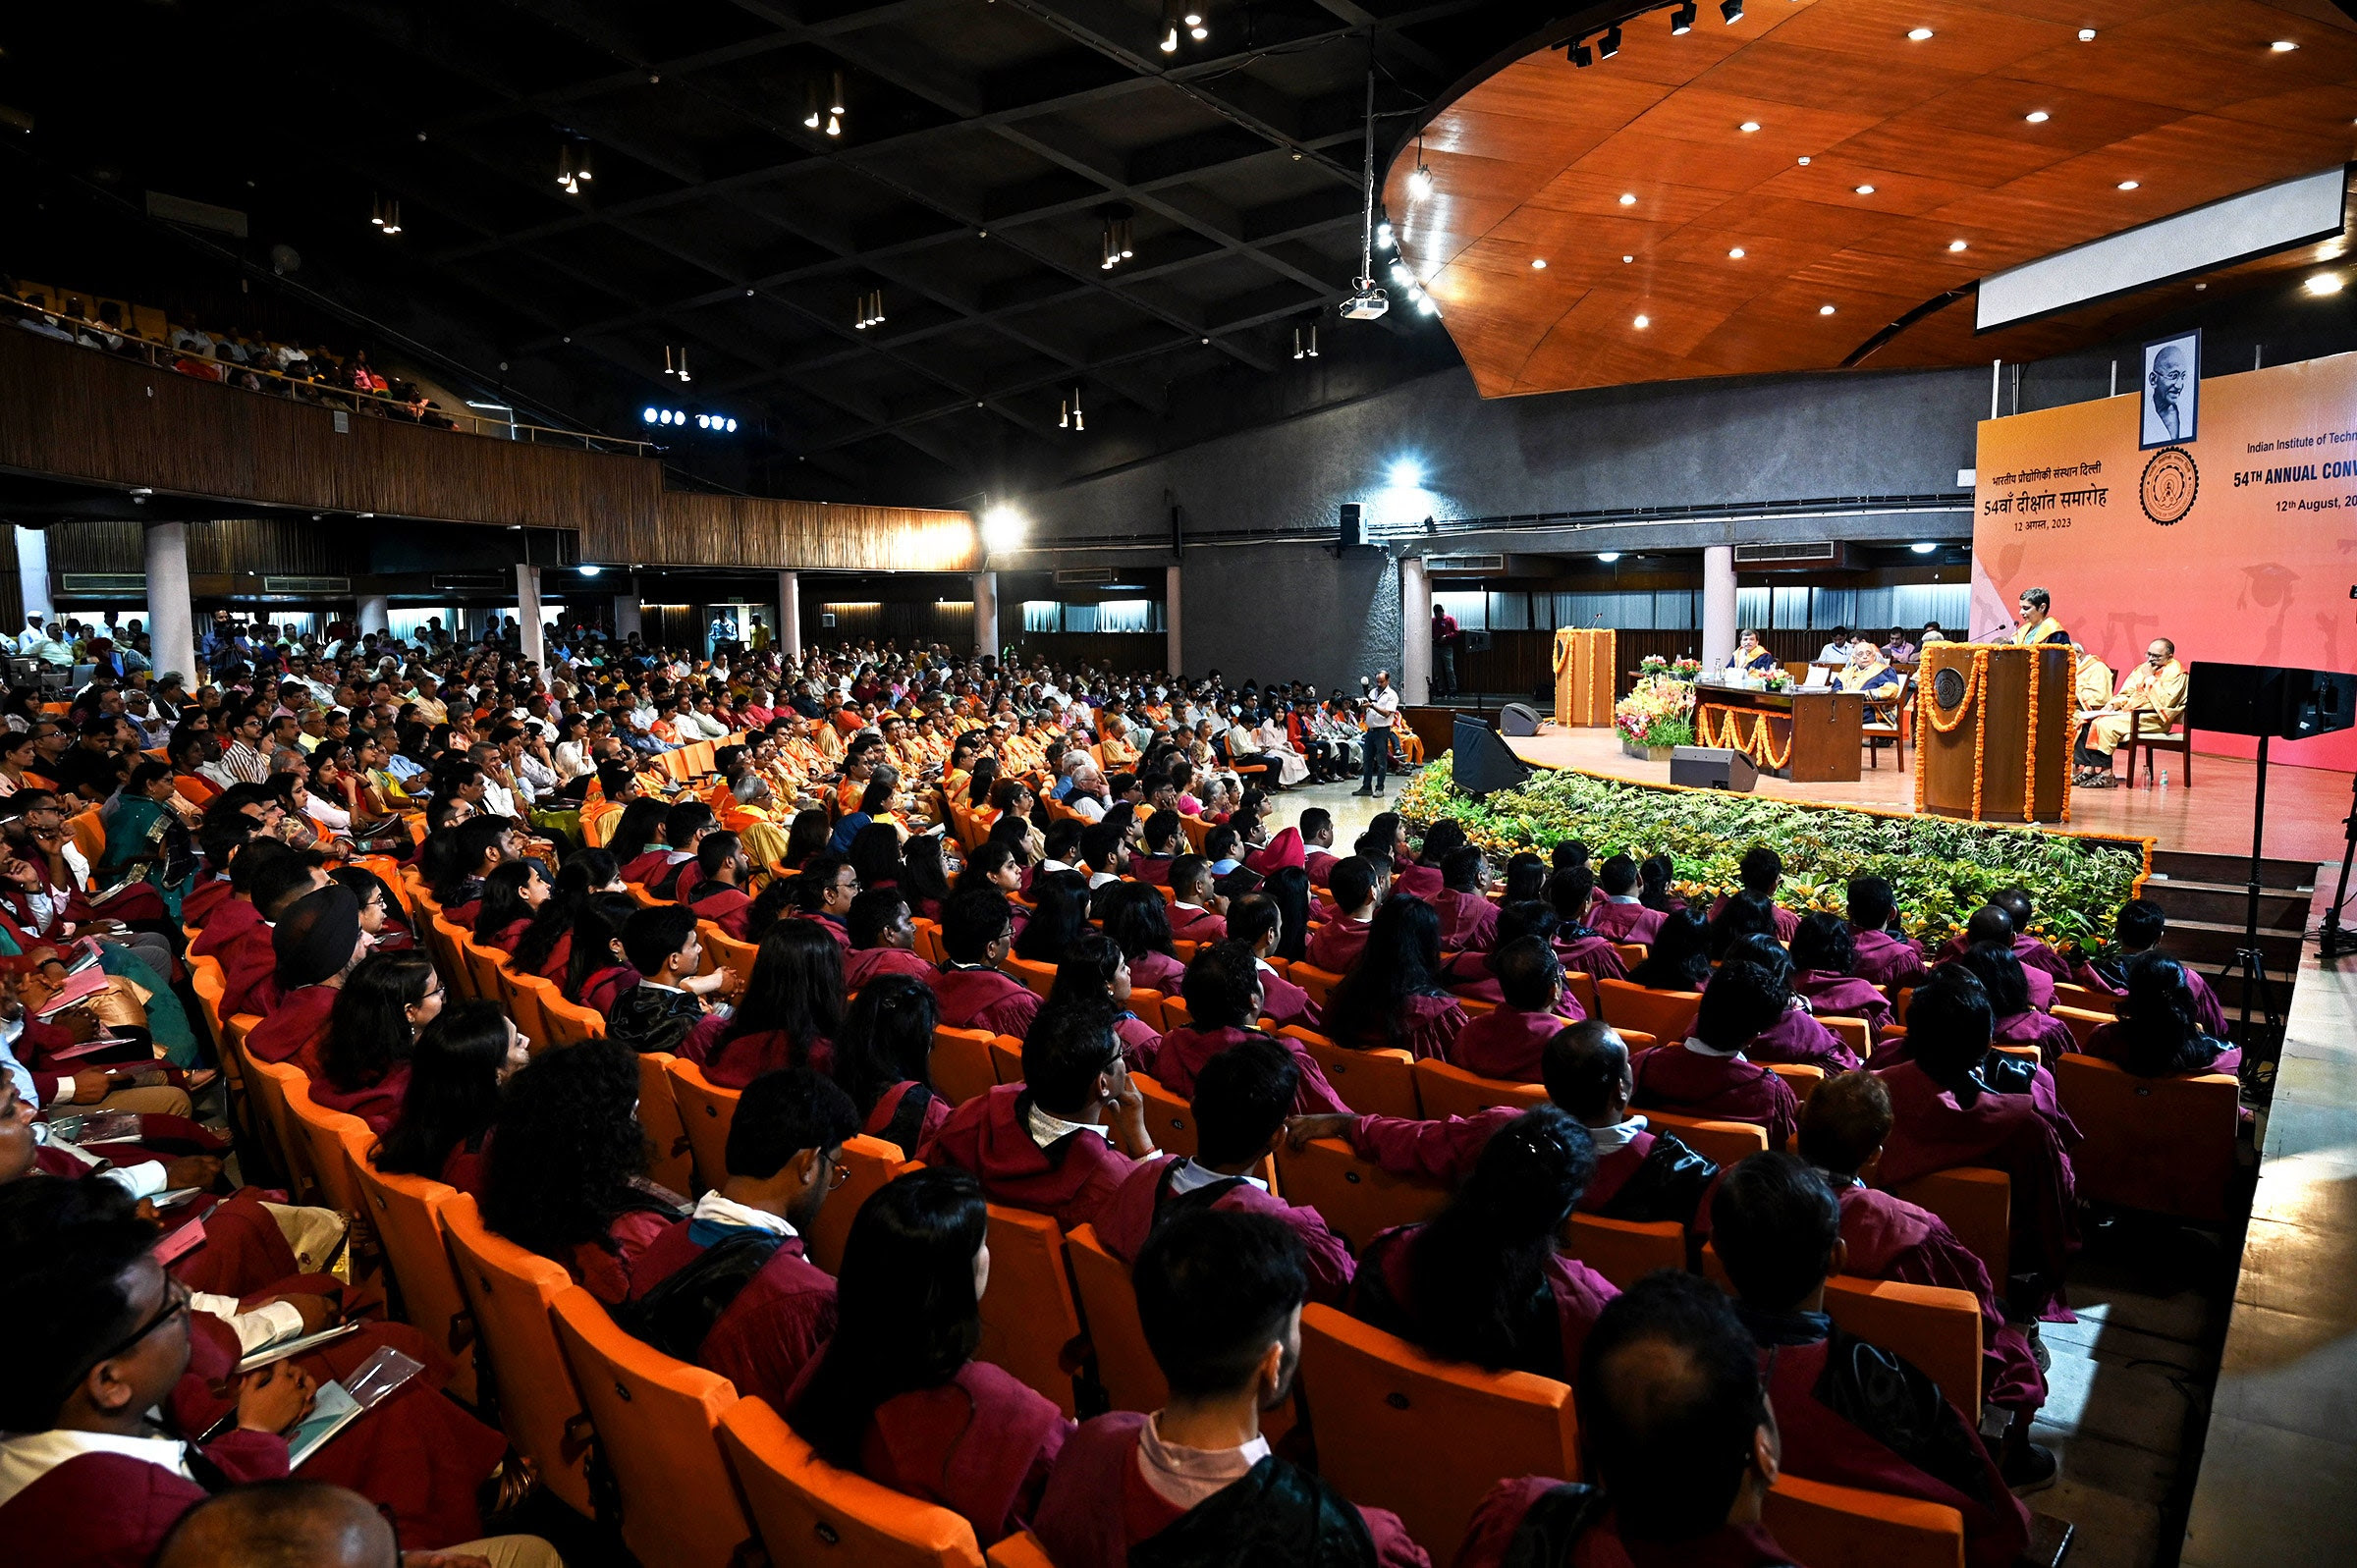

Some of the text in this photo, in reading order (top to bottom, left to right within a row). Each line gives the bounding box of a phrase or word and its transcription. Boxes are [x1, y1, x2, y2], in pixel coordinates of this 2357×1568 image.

[2247, 441, 2275, 454] Indian
[2276, 436, 2314, 450] Institute
[2317, 433, 2328, 446] of
[1992, 460, 2102, 486] भारतीय प्रौद्योगिकी संस्थान दिल्ली
[2233, 470, 2263, 487] 54TH
[2265, 464, 2318, 484] ANNUAL
[1984, 482, 2110, 515] 54वाँ दीक्षांत समारोह
[2275, 501, 2296, 513] 12th
[2298, 497, 2341, 512] August,
[2014, 517, 2072, 532] 12 अगस्त, 2023
